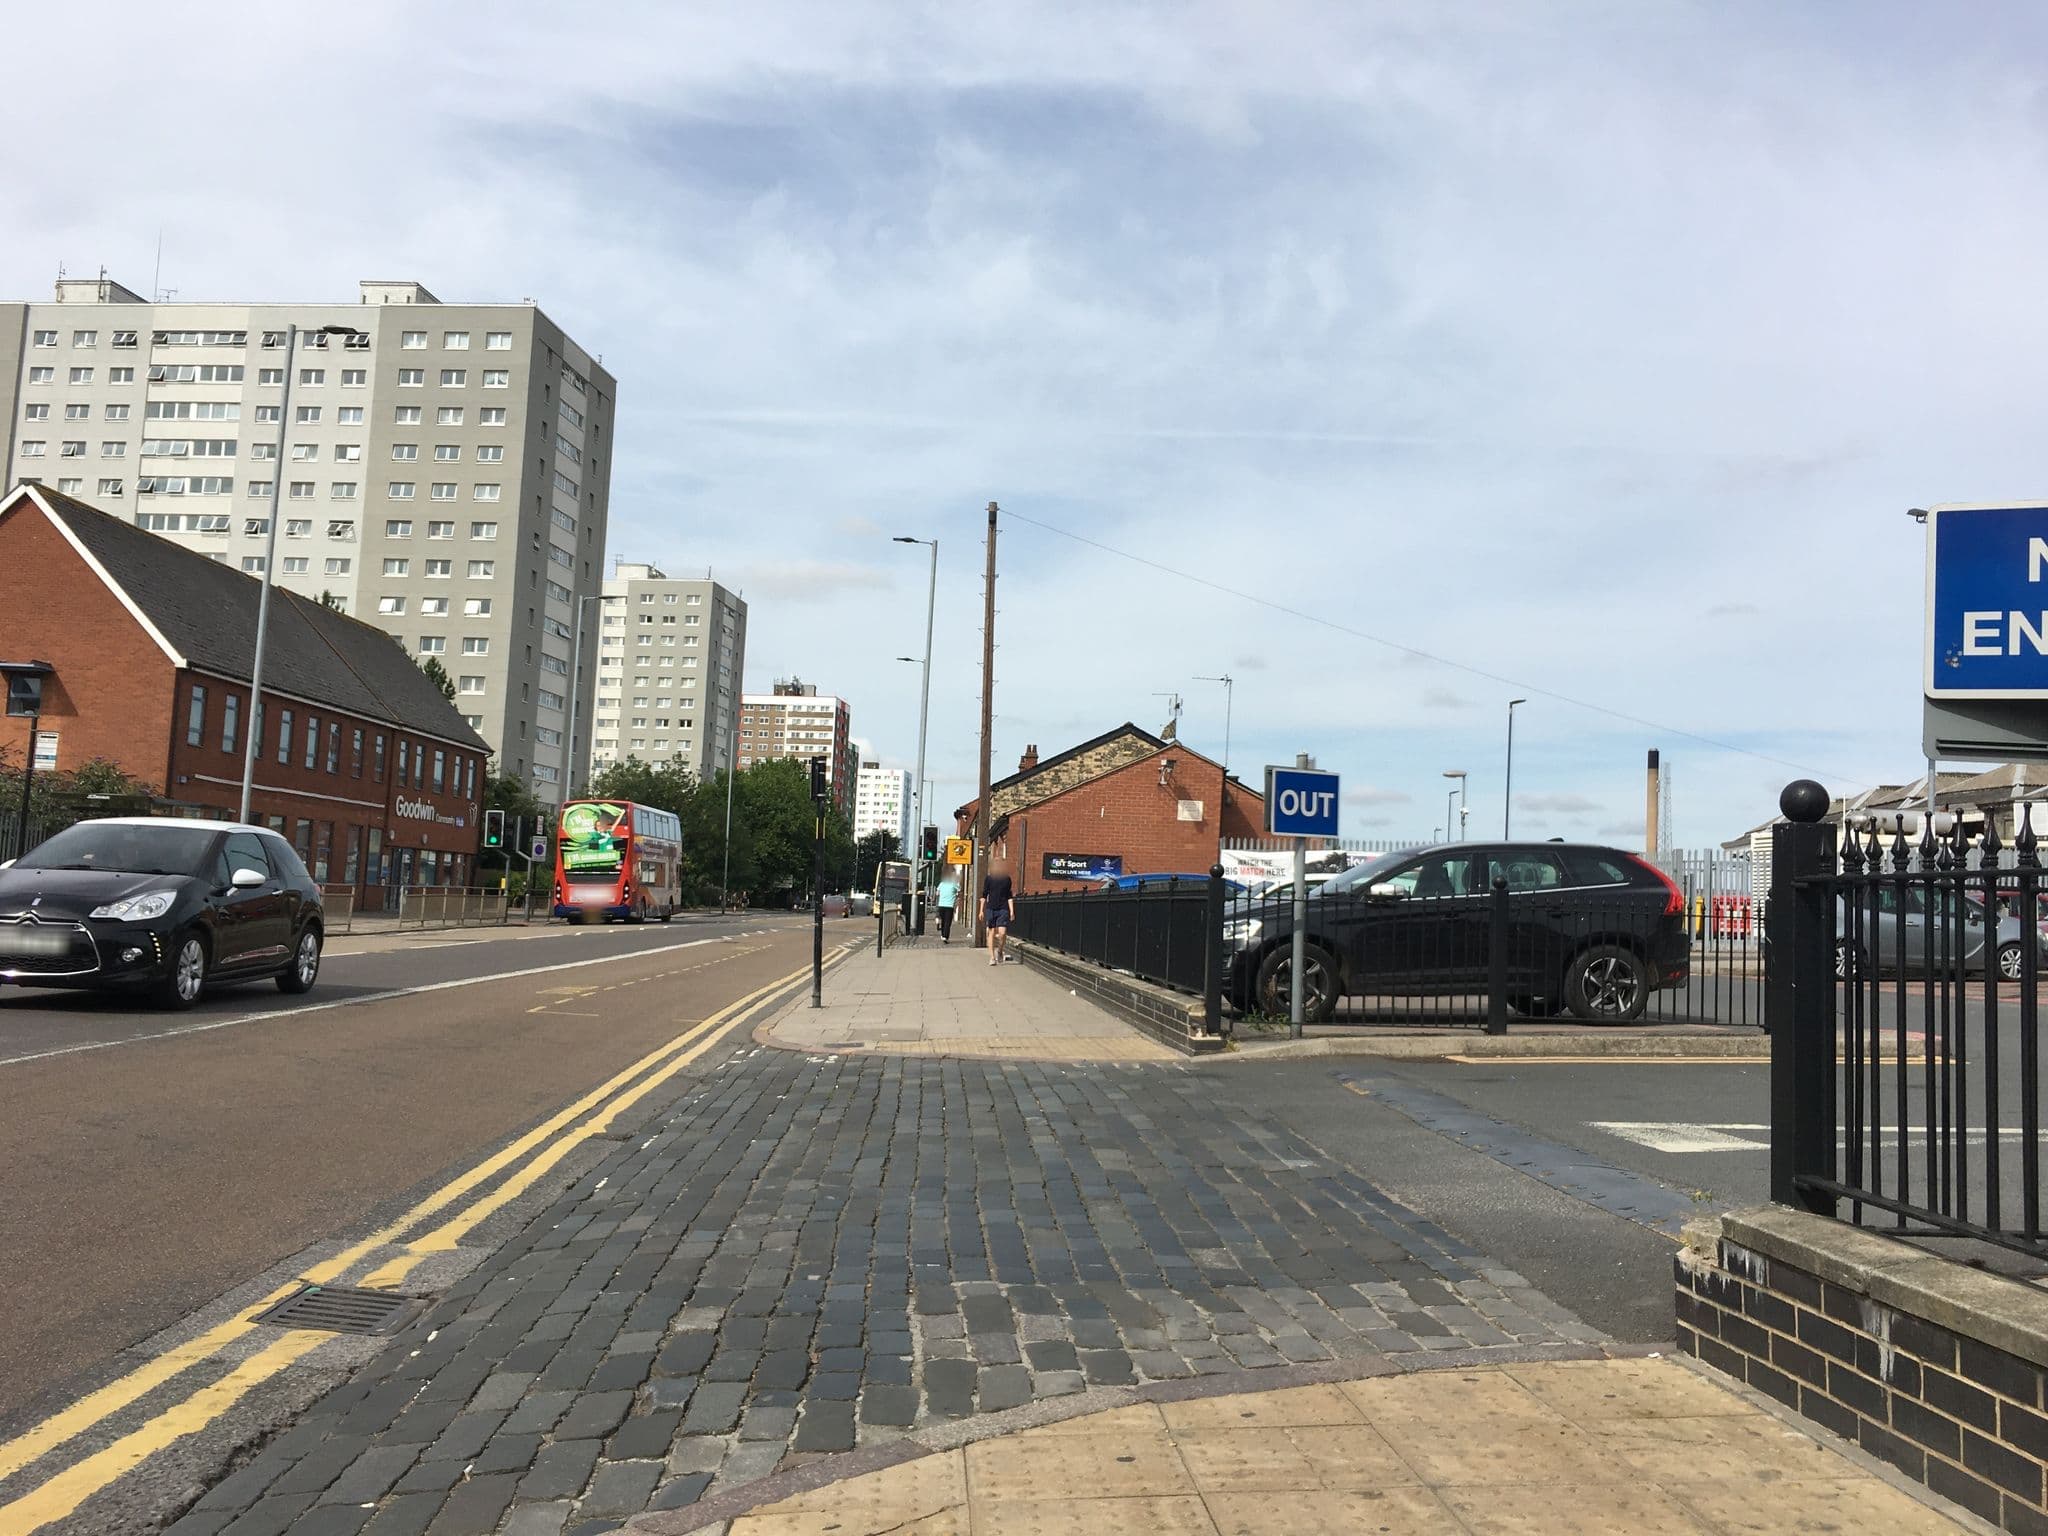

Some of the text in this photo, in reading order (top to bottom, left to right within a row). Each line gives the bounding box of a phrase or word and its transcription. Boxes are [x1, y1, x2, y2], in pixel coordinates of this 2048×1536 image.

[396, 795, 435, 821] Goodwin
[1279, 789, 1335, 818] OUT
[1055, 859, 1087, 868] BT Sport
[1238, 859, 1273, 867] WATCH THE
[1225, 867, 1286, 877] BIG MATCH HERE
